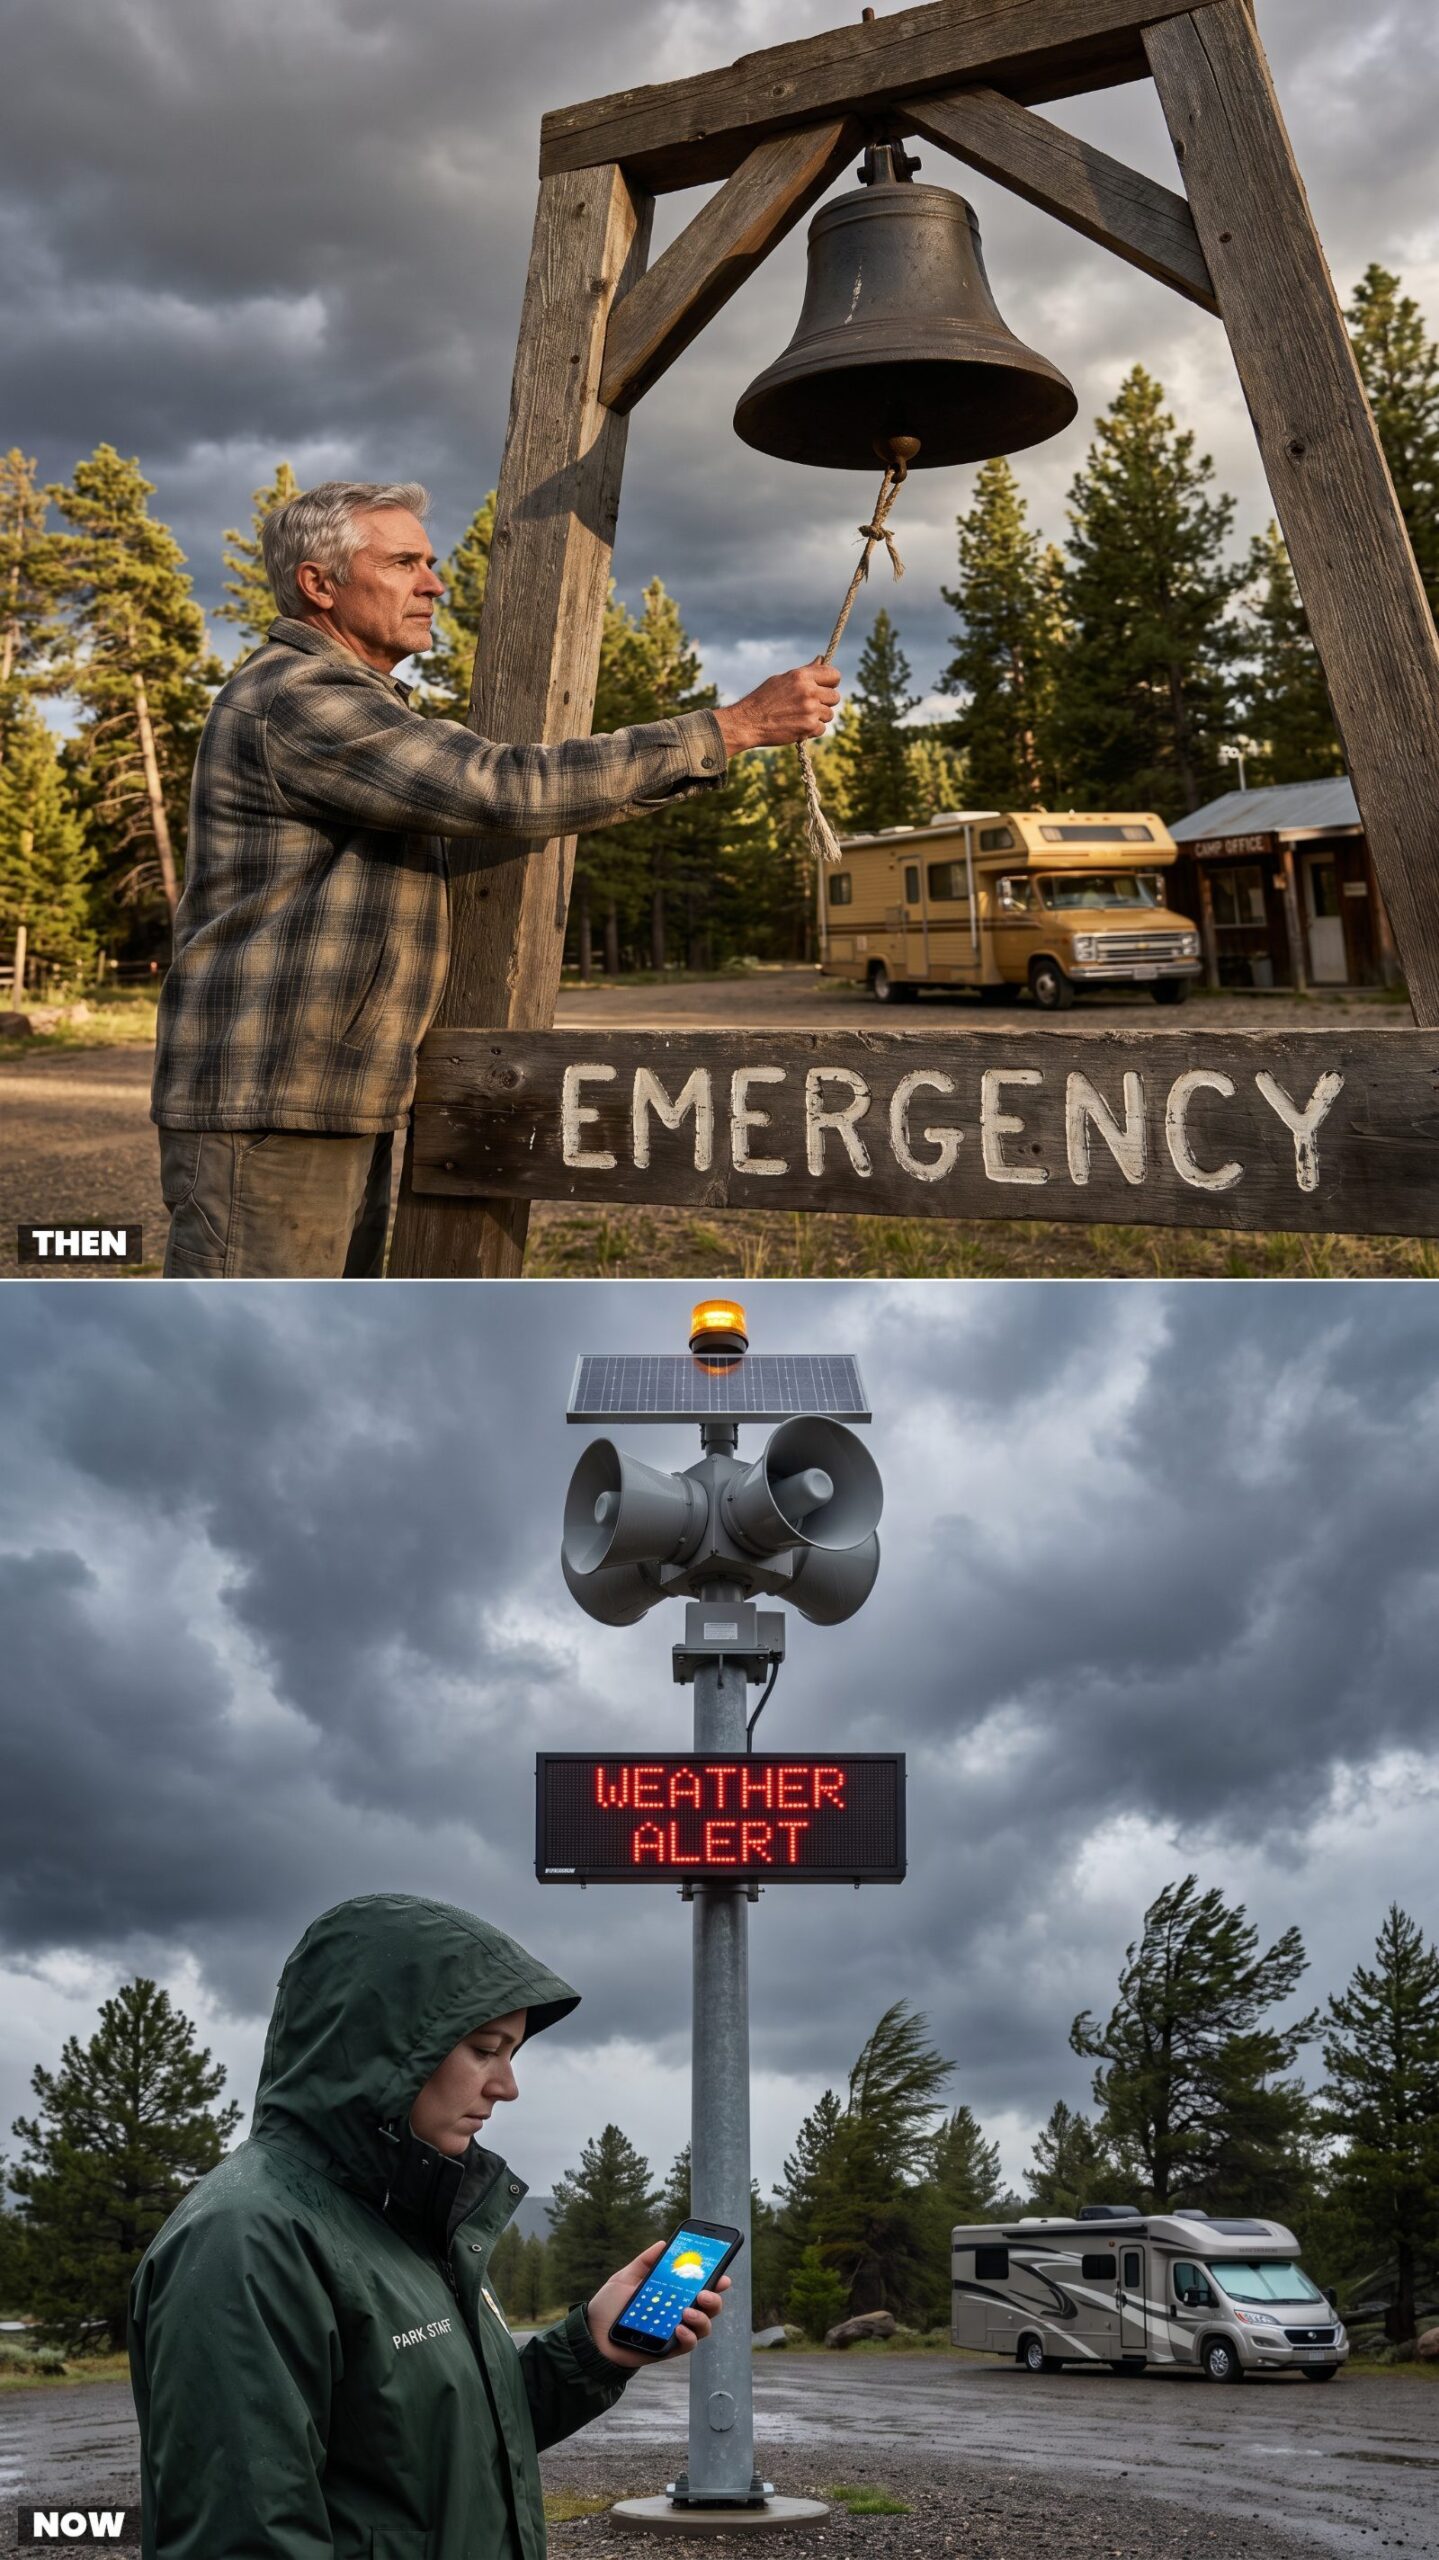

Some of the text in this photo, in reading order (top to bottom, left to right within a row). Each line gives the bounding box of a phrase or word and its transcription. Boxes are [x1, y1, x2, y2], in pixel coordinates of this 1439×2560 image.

[1194, 835, 1264, 857] CAMP OFFICE
[561, 1062, 1346, 1193] EMERGENCY
[596, 1767, 845, 1808] WEATHER
[633, 1821, 809, 1863] ALERT
[392, 2318, 452, 2350] PARK STAFF
